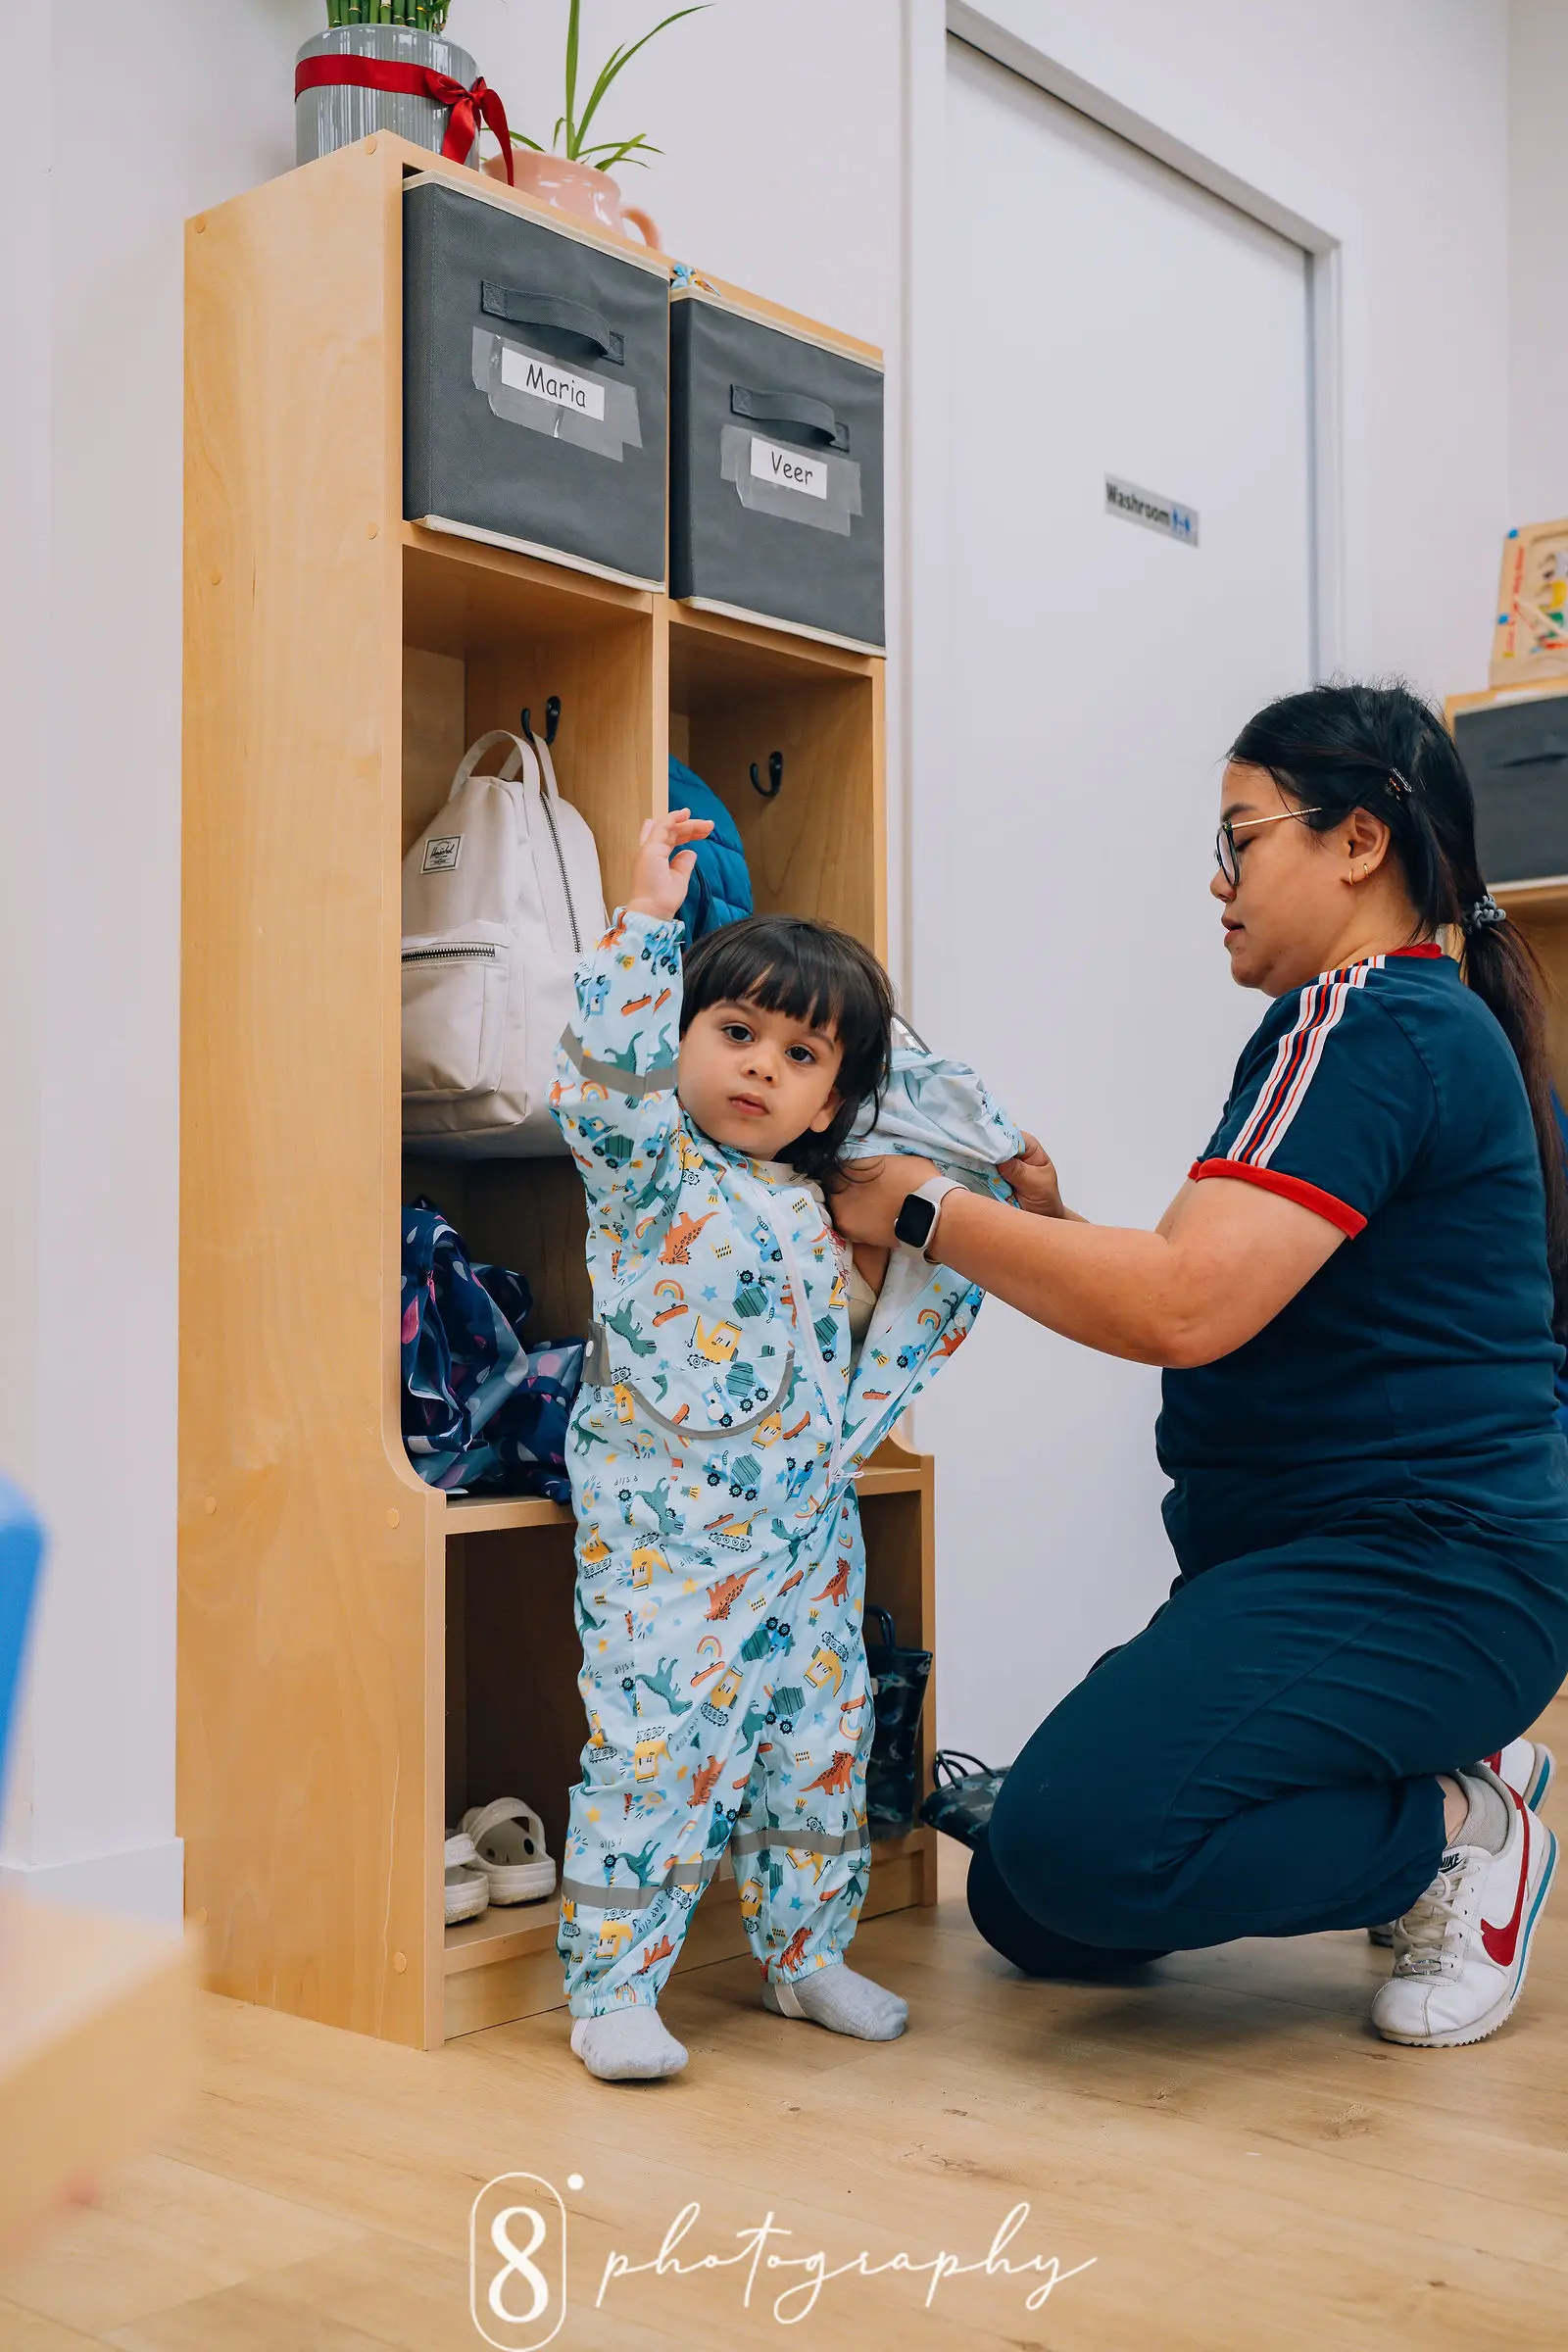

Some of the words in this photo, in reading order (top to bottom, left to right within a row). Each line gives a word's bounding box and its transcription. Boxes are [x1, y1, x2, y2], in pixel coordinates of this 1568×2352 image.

[525, 364, 586, 409] Maria
[771, 451, 813, 484] Veer
[596, 1299, 608, 1309] sli
